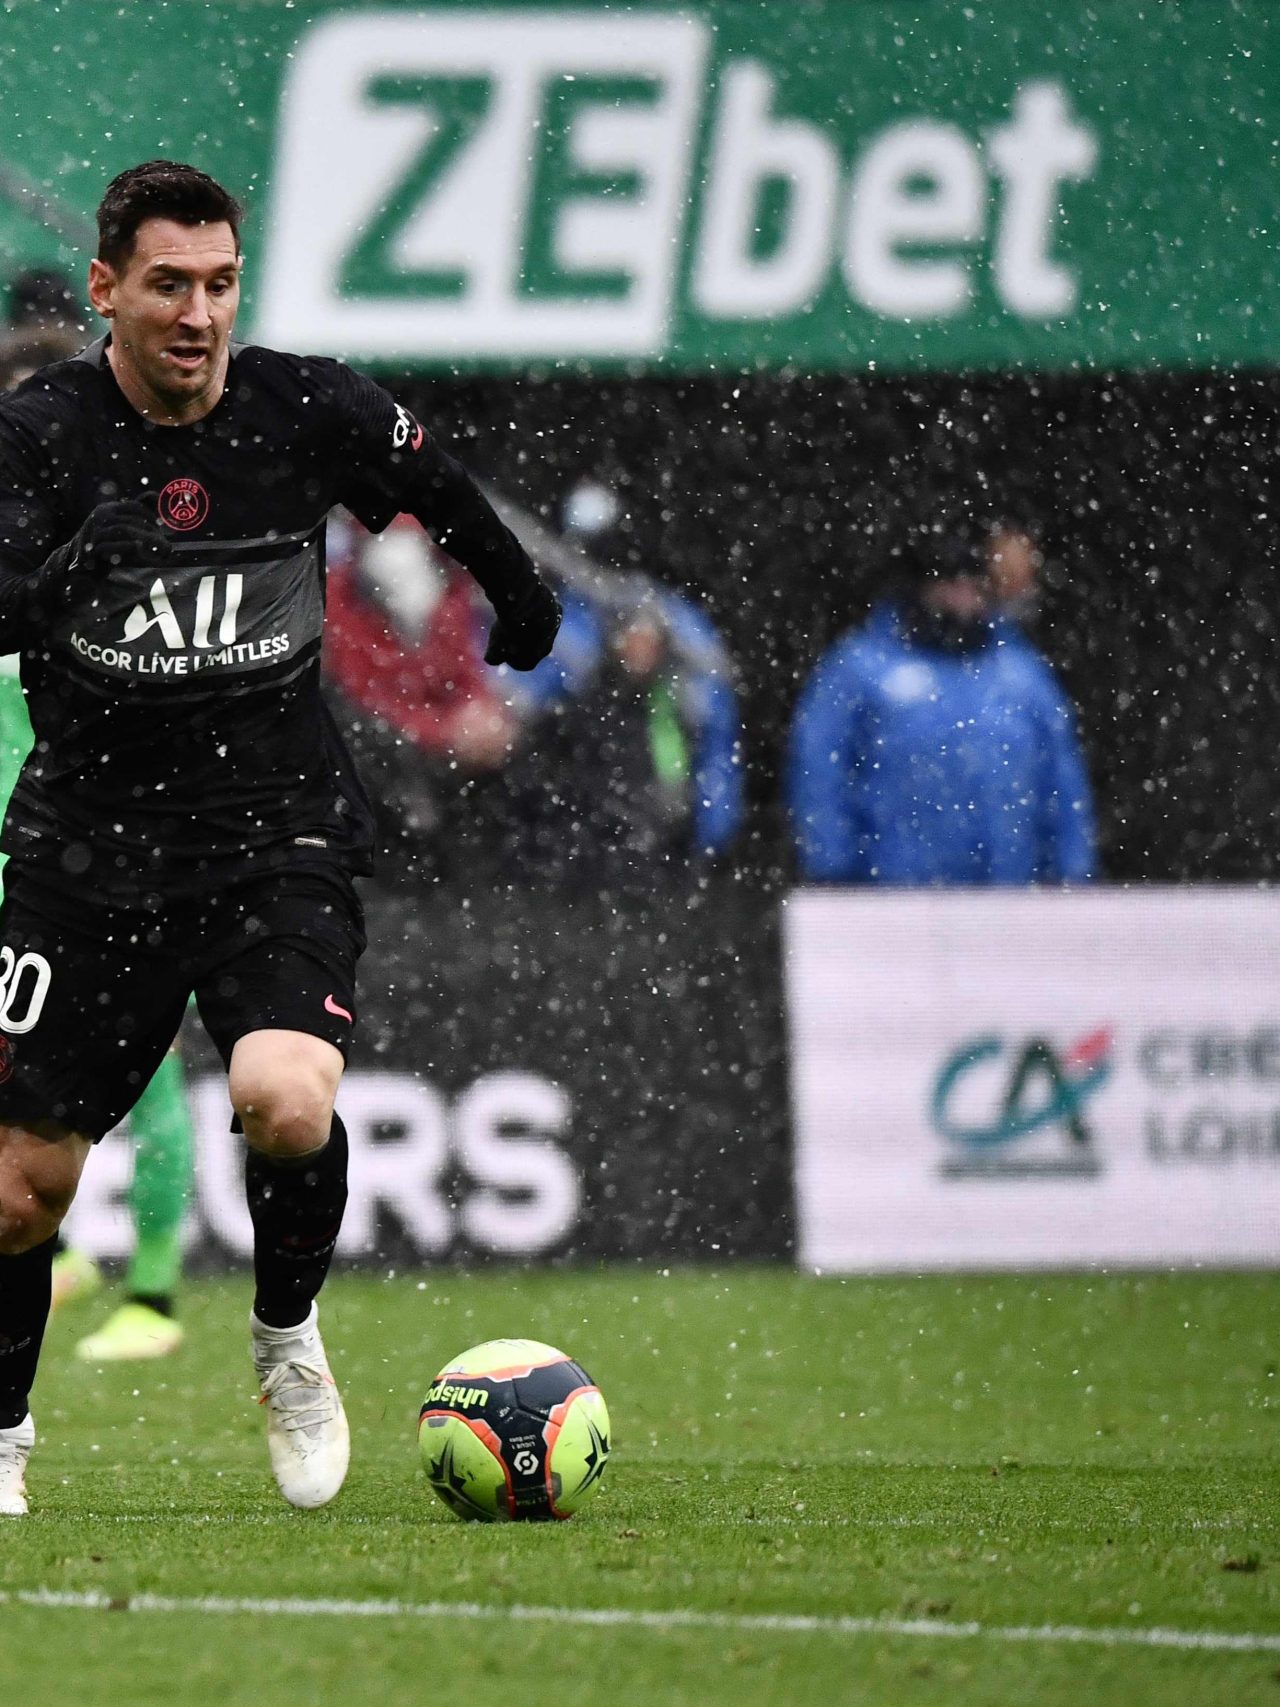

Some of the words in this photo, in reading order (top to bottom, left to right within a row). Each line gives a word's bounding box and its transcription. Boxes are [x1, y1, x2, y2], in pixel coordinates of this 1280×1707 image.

[332, 56, 1100, 320] ZEbet
[166, 481, 199, 495] PARIS
[70, 631, 132, 671] ACCOR
[1142, 1106, 1280, 1166] LOI
